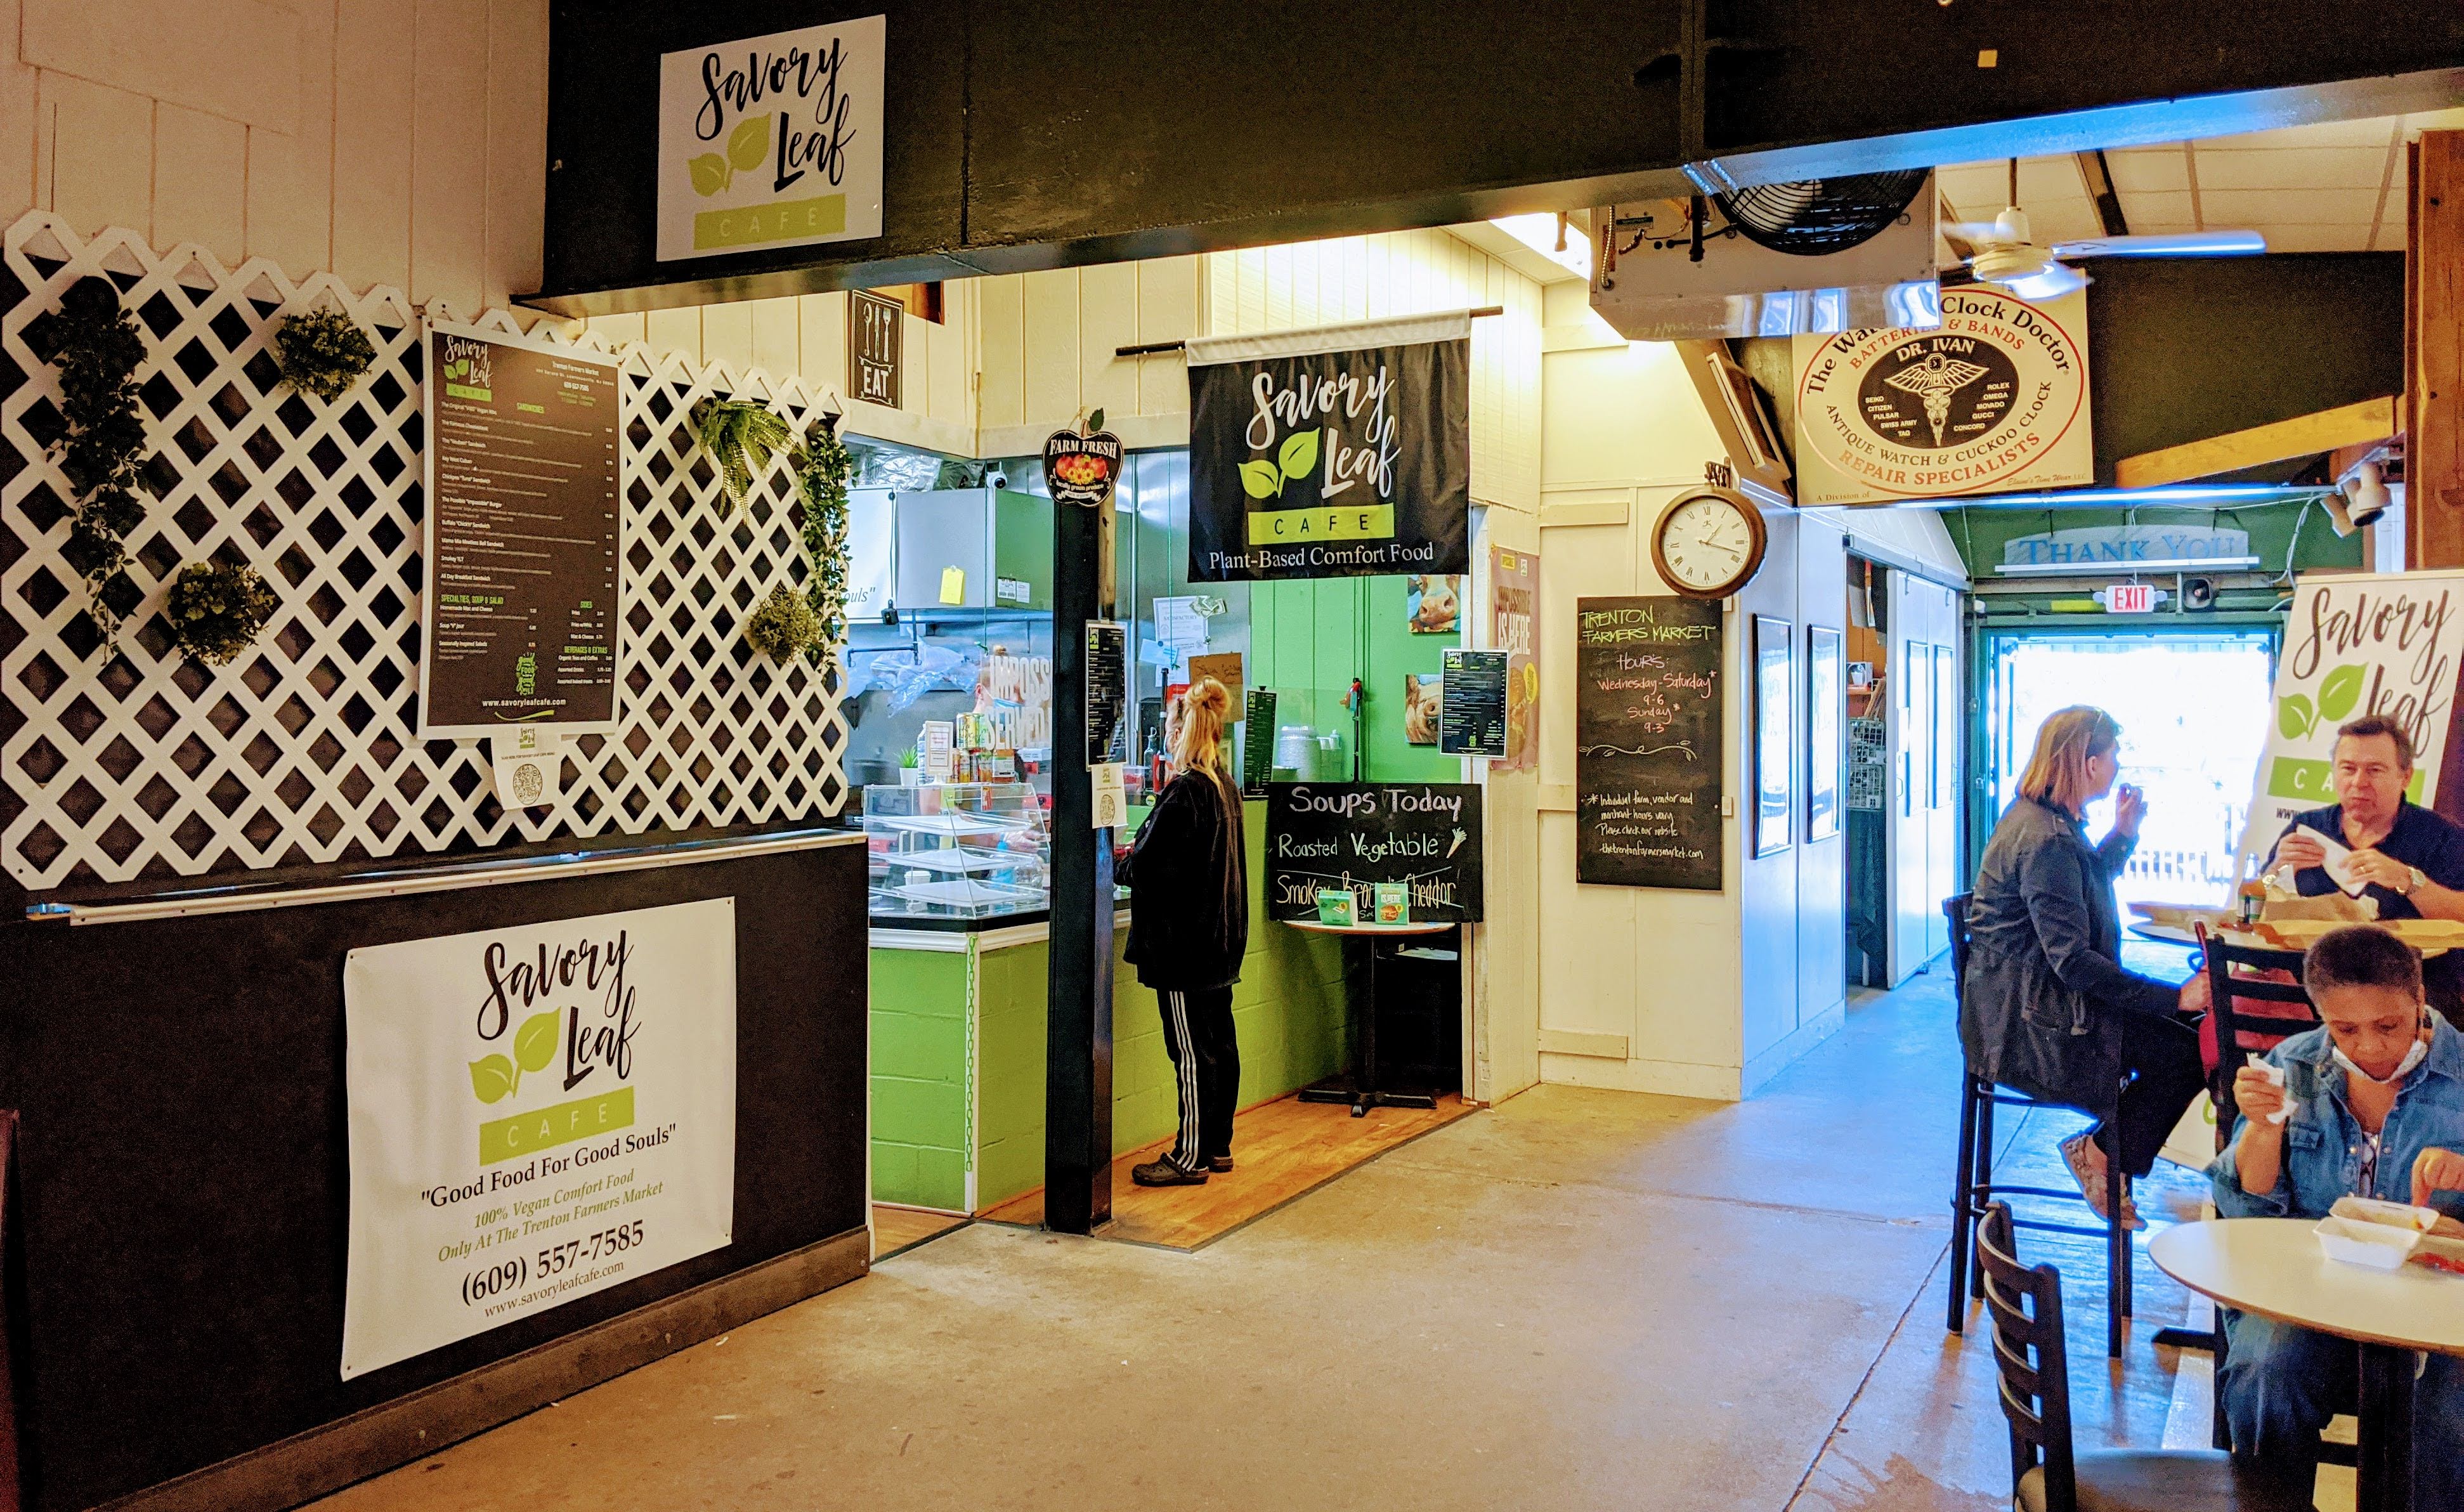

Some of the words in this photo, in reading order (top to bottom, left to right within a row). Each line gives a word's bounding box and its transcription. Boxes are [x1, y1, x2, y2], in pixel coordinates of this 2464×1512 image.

[696, 38, 848, 141] Savory
[774, 94, 856, 192] Leaf
[720, 207, 818, 237] CAFE
[445, 335, 487, 369] Savory
[1807, 358, 1836, 394] The
[1941, 296, 2006, 320] Clock
[2012, 309, 2070, 370] Doctor
[1849, 325, 1941, 369] BATTERI
[1948, 319, 1961, 330] &
[1967, 320, 2024, 350] BANDS
[1896, 342, 1927, 362] DR.
[1933, 338, 1976, 355] IVAN
[470, 360, 493, 388] Leaf
[863, 367, 889, 398] EAT
[1987, 382, 2009, 390] ROLEX
[1246, 366, 1395, 450] Savory
[1867, 404, 1892, 412] CITIZEN
[1976, 401, 2005, 410] MOVADO
[1983, 392, 2008, 400] OMEGA
[1827, 405, 1875, 455] ANTIQUE
[1881, 448, 1930, 466] WATCH
[1938, 454, 1949, 465] &
[1955, 428, 2017, 462] CUCKOO
[2019, 381, 2052, 427] CLOCK
[1953, 423, 1985, 431] CONCORD
[1049, 439, 1079, 455] FARM
[1081, 441, 1118, 459] FRESH
[1321, 415, 1402, 499] Leaf
[1839, 450, 1906, 484] REPAIR
[1913, 433, 2040, 485] SPECIALISTS
[1826, 493, 1860, 501] Division
[1275, 514, 1369, 535] CAFE
[1209, 548, 1305, 569] Plant-Based
[1310, 545, 1386, 565] Comfort
[1390, 542, 1434, 562] Food
[844, 587, 876, 603] ouls"
[2114, 587, 2148, 610] EXIT
[1579, 605, 1654, 629] TRENTON
[1498, 613, 1508, 649] IS
[1509, 613, 1530, 655] HERE
[1582, 627, 1648, 644] FARMERS
[1653, 625, 1716, 642] MARKET
[2293, 587, 2456, 685] Savory
[482, 698, 566, 708] www.savoryleafcafe.com
[984, 705, 1045, 751] SERVED
[1289, 786, 1376, 818] Soups
[1381, 786, 1462, 822] Today
[1633, 808, 1653, 820] hours
[1679, 792, 1693, 805] and
[1622, 824, 1640, 835] check
[1641, 827, 1653, 835] our
[1279, 833, 1338, 858] Roasted
[1351, 832, 1438, 863] Vegetable
[1599, 840, 1704, 859] thetrentonfarmersmarket.com
[1276, 875, 1331, 906] Smoke
[477, 930, 634, 1040] Savory
[563, 986, 641, 1092] Leaf
[508, 1103, 607, 1147] CAFE
[421, 1175, 484, 1208] "Good
[490, 1161, 535, 1192] Food
[542, 1156, 570, 1178] For
[575, 1139, 620, 1166] Good
[626, 1123, 676, 1153] Souls"
[474, 1207, 508, 1228] 100%
[513, 1197, 550, 1218] Vegan
[554, 1178, 603, 1204] Comfort
[606, 1168, 635, 1189] Food
[438, 1241, 472, 1262] Only
[474, 1234, 492, 1251] At
[497, 1227, 518, 1244] The
[523, 1214, 570, 1235] Trenton
[574, 1195, 620, 1217] Farmers
[623, 1181, 664, 1205] Market
[462, 1256, 527, 1307] (609)
[537, 1220, 644, 1280] 557-7585
[485, 1261, 624, 1317] www.savoryleafcafe.com
